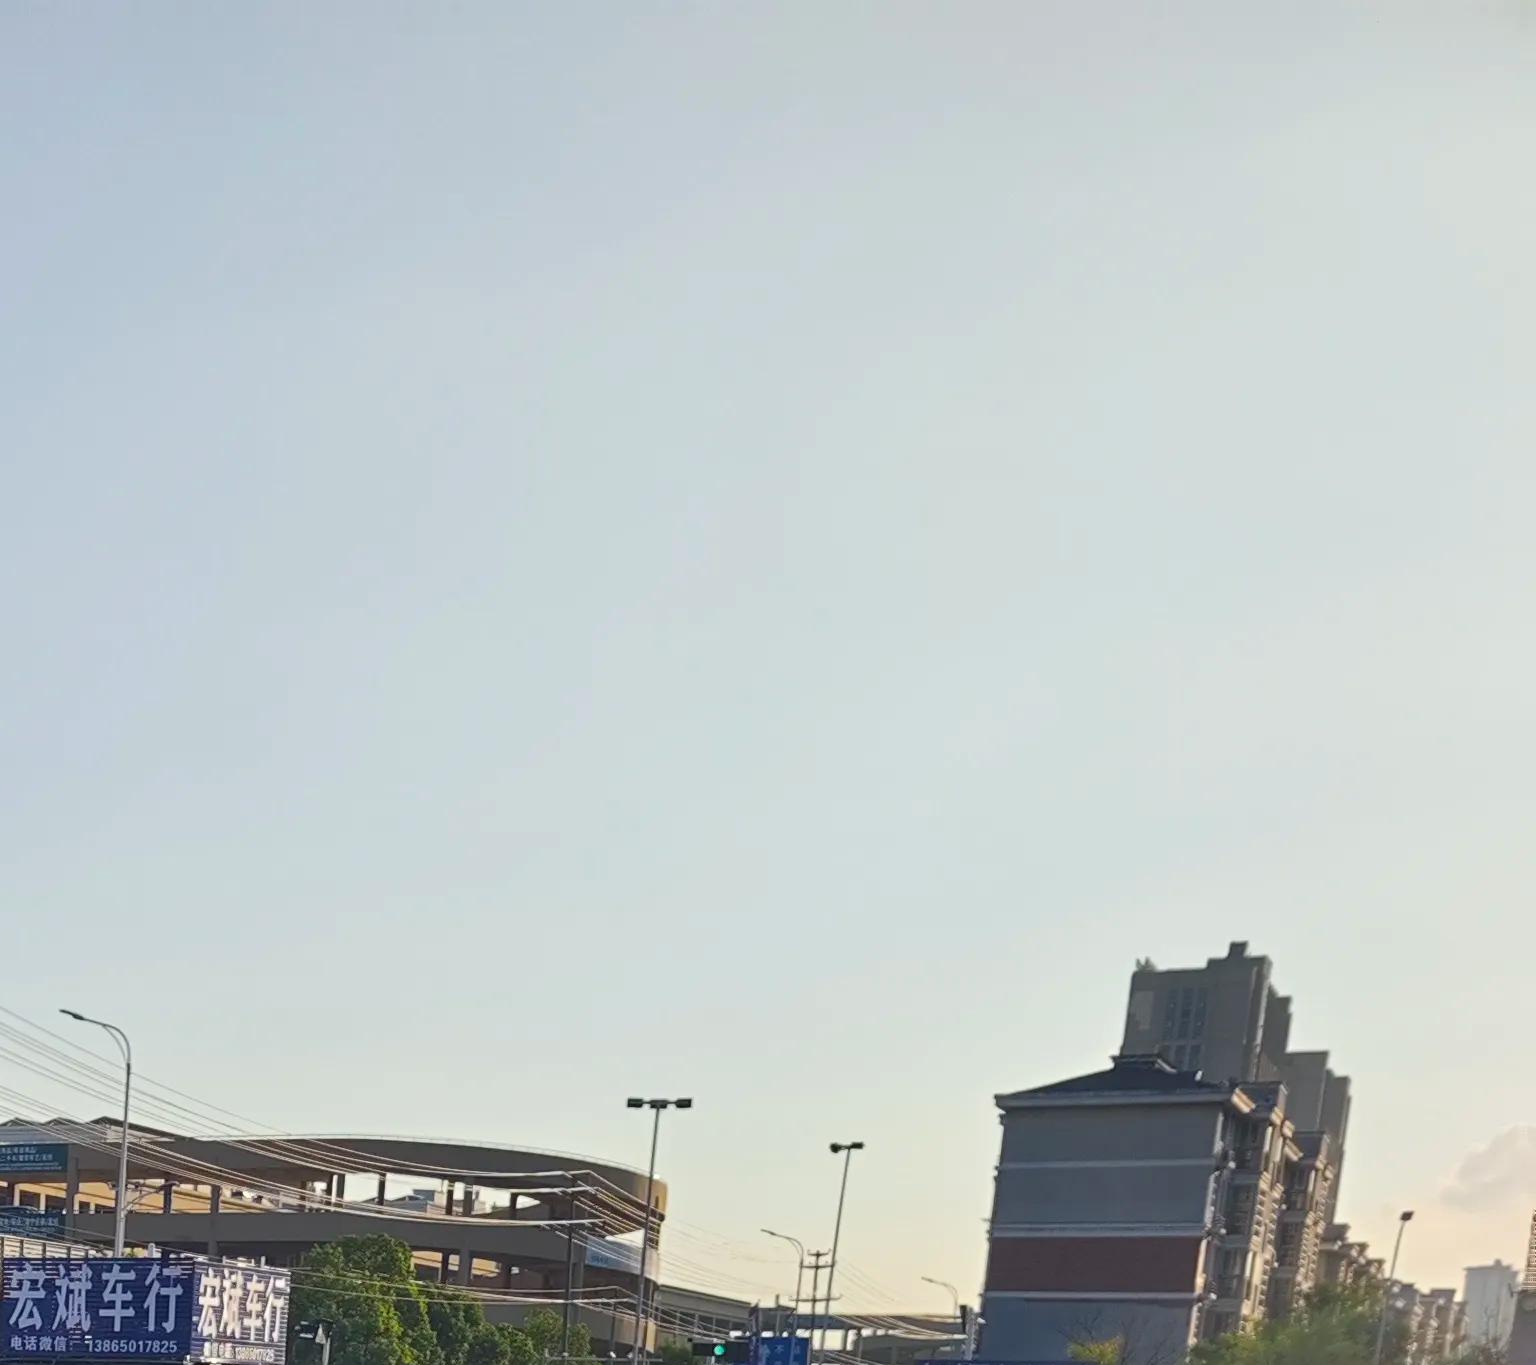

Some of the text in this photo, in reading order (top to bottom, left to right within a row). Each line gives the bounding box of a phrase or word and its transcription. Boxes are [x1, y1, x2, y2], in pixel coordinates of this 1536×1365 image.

[8, 1261, 184, 1334] 宏斌车行
[197, 1266, 289, 1343] 宏斌车行
[87, 1338, 179, 1354] 13865017825
